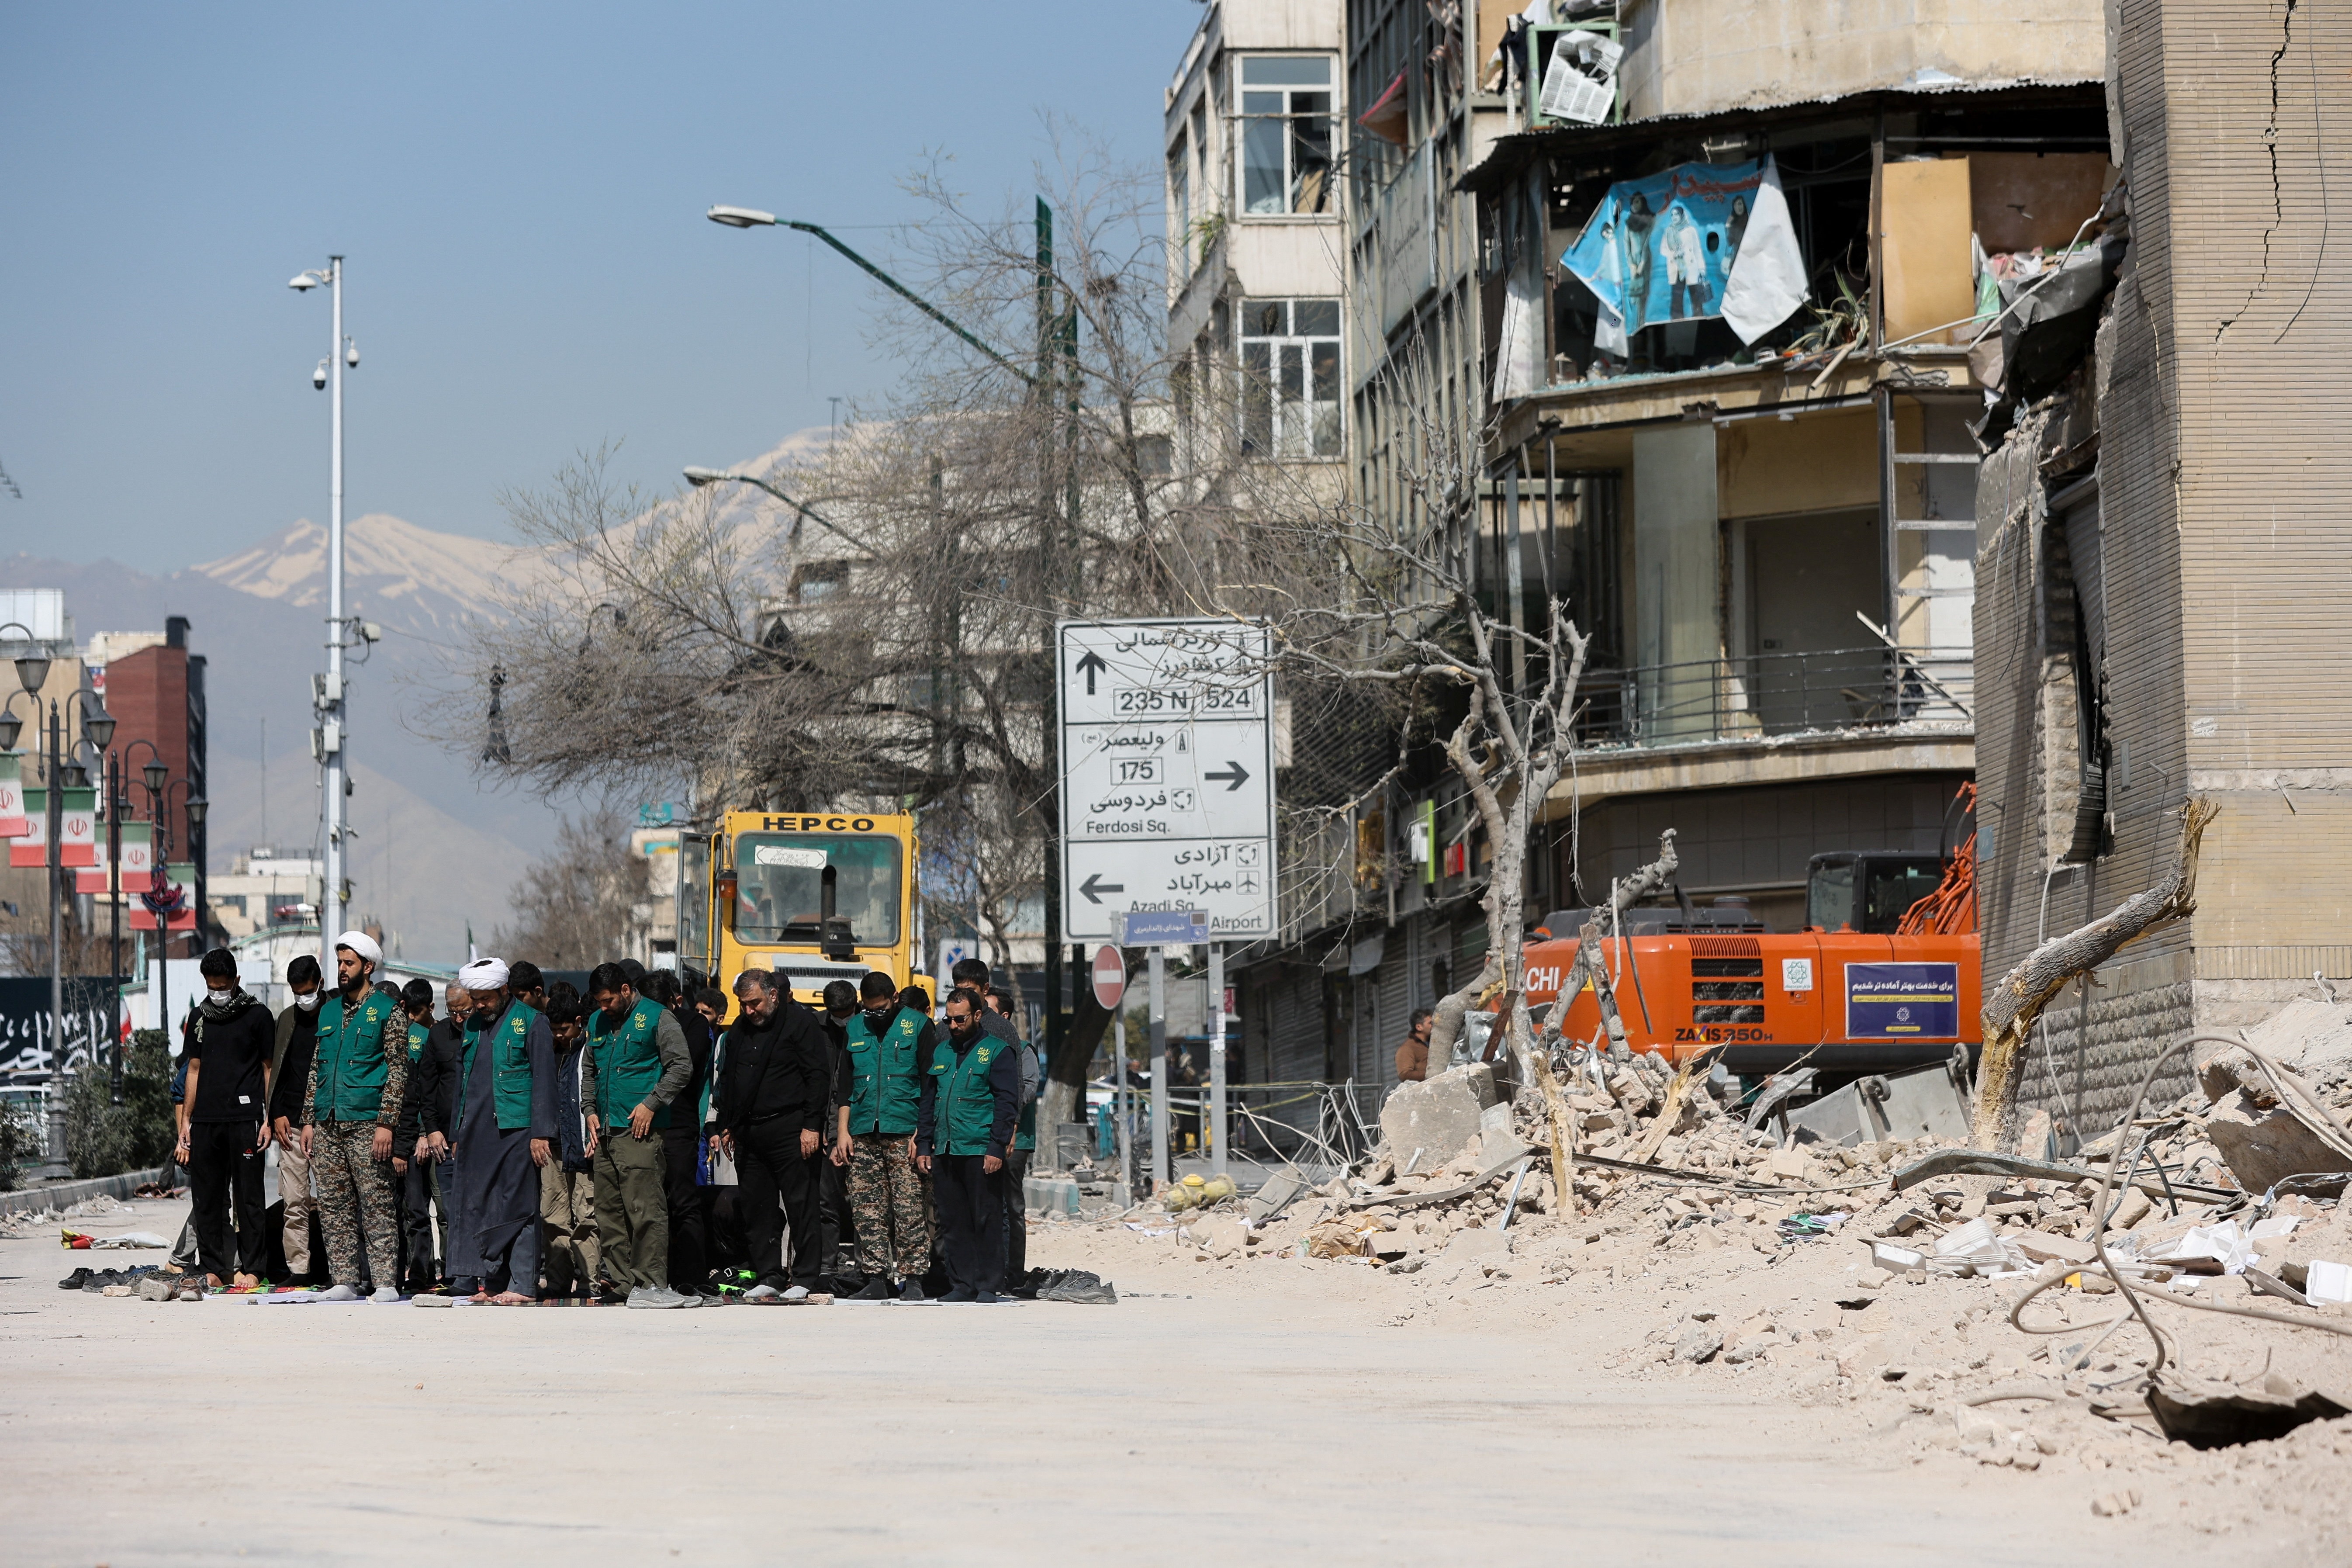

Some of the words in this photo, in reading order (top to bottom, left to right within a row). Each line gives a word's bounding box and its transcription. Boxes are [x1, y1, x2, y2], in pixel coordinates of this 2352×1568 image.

[1115, 631, 1176, 652] شمالی
[1120, 692, 1162, 710] 235
[1171, 691, 1186, 709] N
[1207, 690, 1250, 708] 524
[1100, 731, 1164, 752] ولیعصر
[1119, 761, 1153, 780] 175
[1090, 790, 1166, 813] فردوسی
[763, 817, 874, 831] HEPCO
[1086, 819, 1142, 834] Ferdosi
[1146, 819, 1171, 834] Sq.
[1174, 844, 1231, 866] آزادی
[1167, 873, 1231, 896] مهرآباد
[1130, 900, 1170, 913] Azadi
[1211, 916, 1262, 932] Airport
[1852, 981, 1873, 992] شدیم
[1900, 982, 1916, 991] بهتر
[1916, 981, 1939, 990] خدمت
[1939, 981, 1953, 991] برای
[1675, 1025, 1721, 1042] ZAXIS
